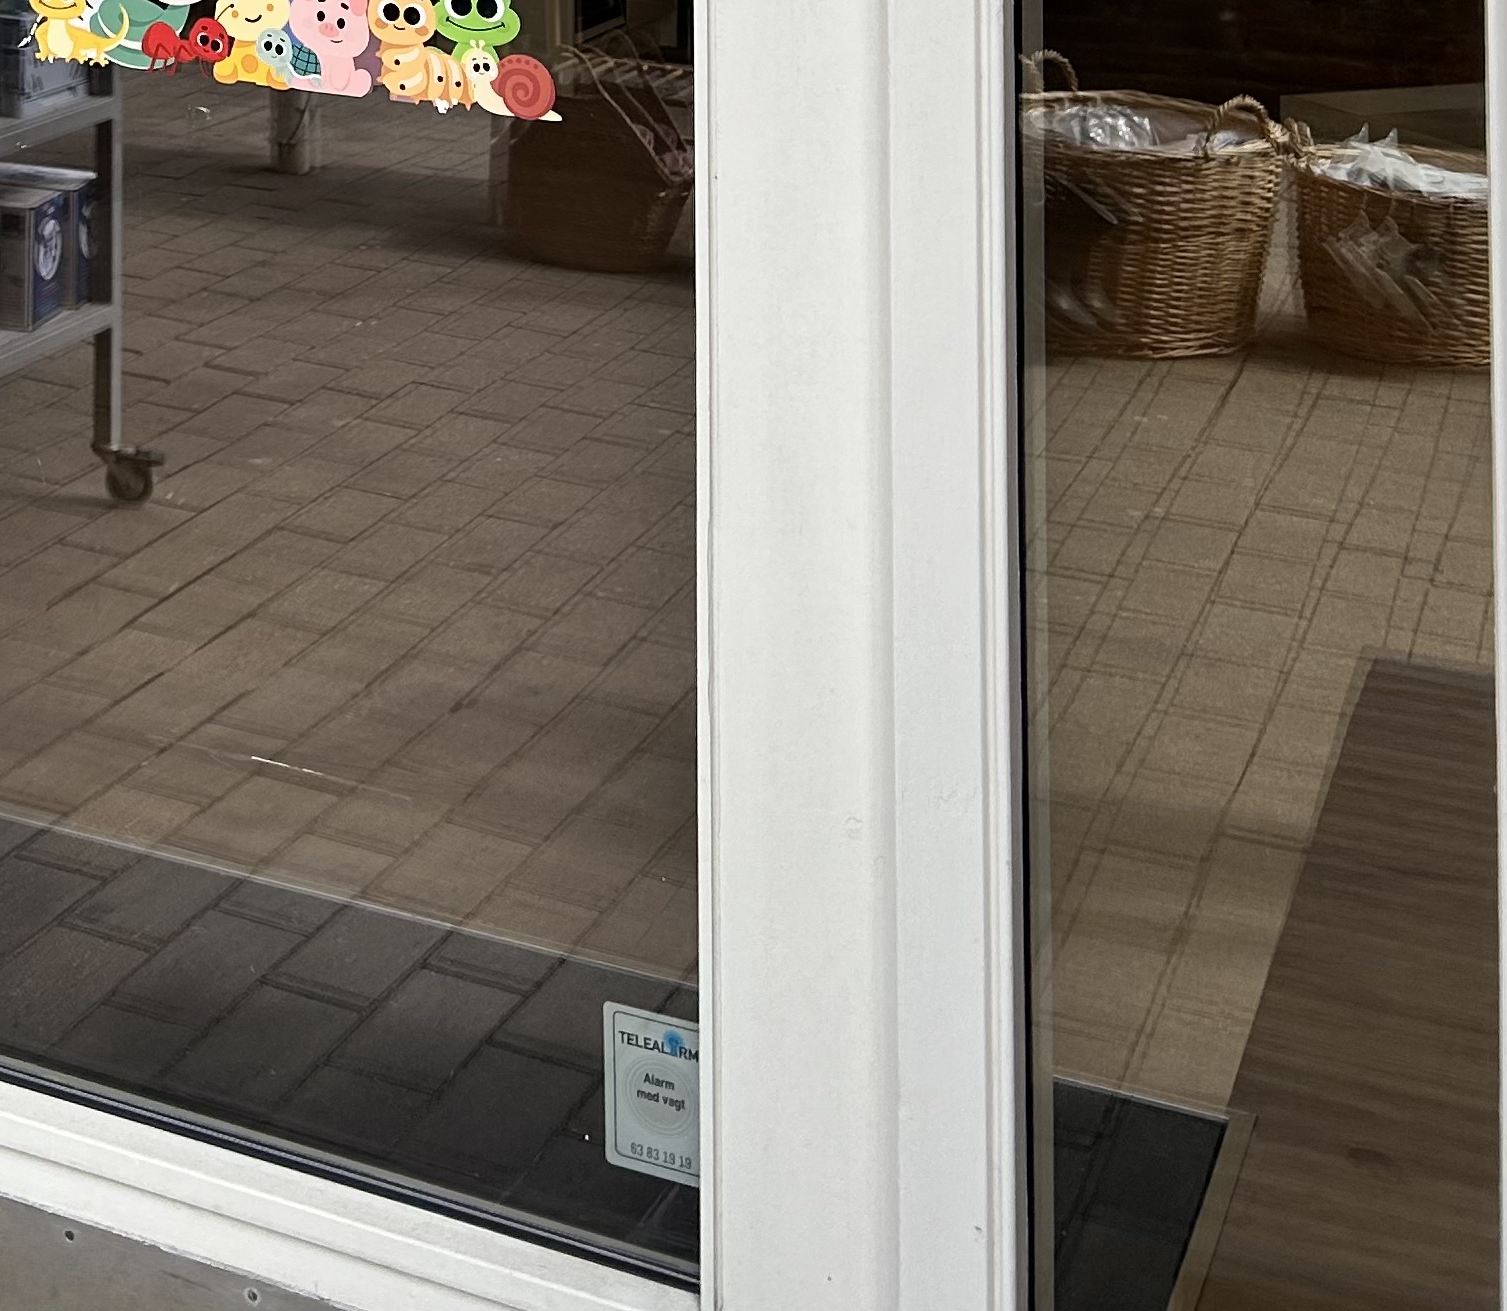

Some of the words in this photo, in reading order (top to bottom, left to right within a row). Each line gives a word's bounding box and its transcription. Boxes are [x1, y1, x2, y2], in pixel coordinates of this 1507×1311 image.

[643, 1072, 675, 1090] Alarm
[636, 1089, 660, 1103] med
[662, 1095, 686, 1112] vagt
